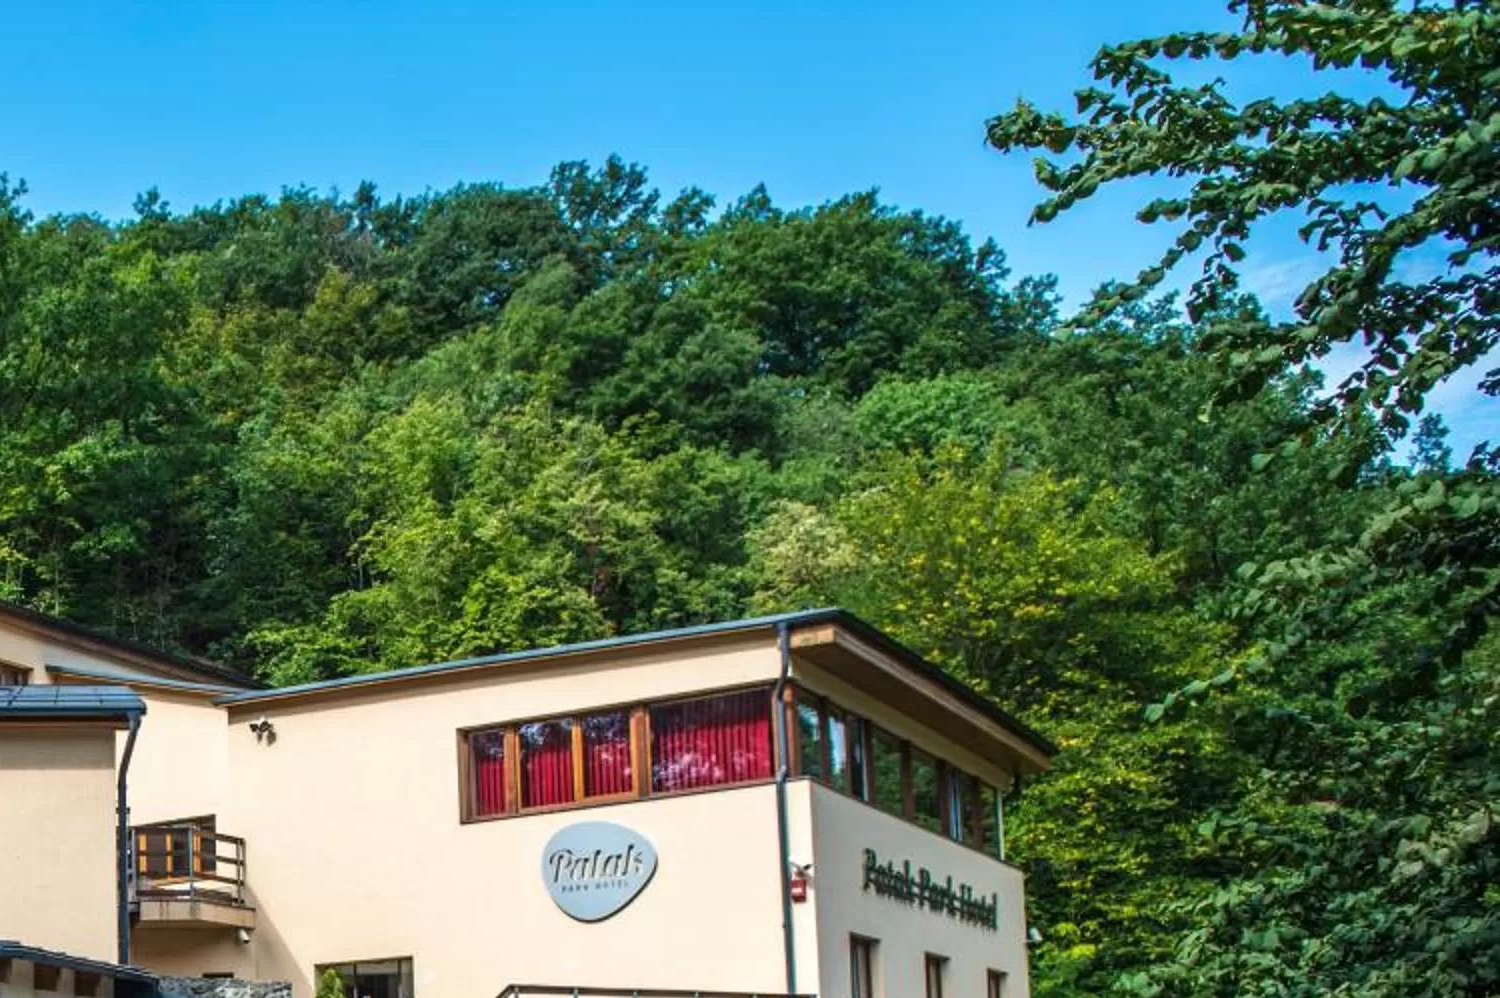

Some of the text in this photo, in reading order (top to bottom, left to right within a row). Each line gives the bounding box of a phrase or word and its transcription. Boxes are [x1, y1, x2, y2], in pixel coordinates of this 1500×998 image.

[550, 844, 643, 883] Patak
[862, 848, 998, 931] Patak Park Hotel
